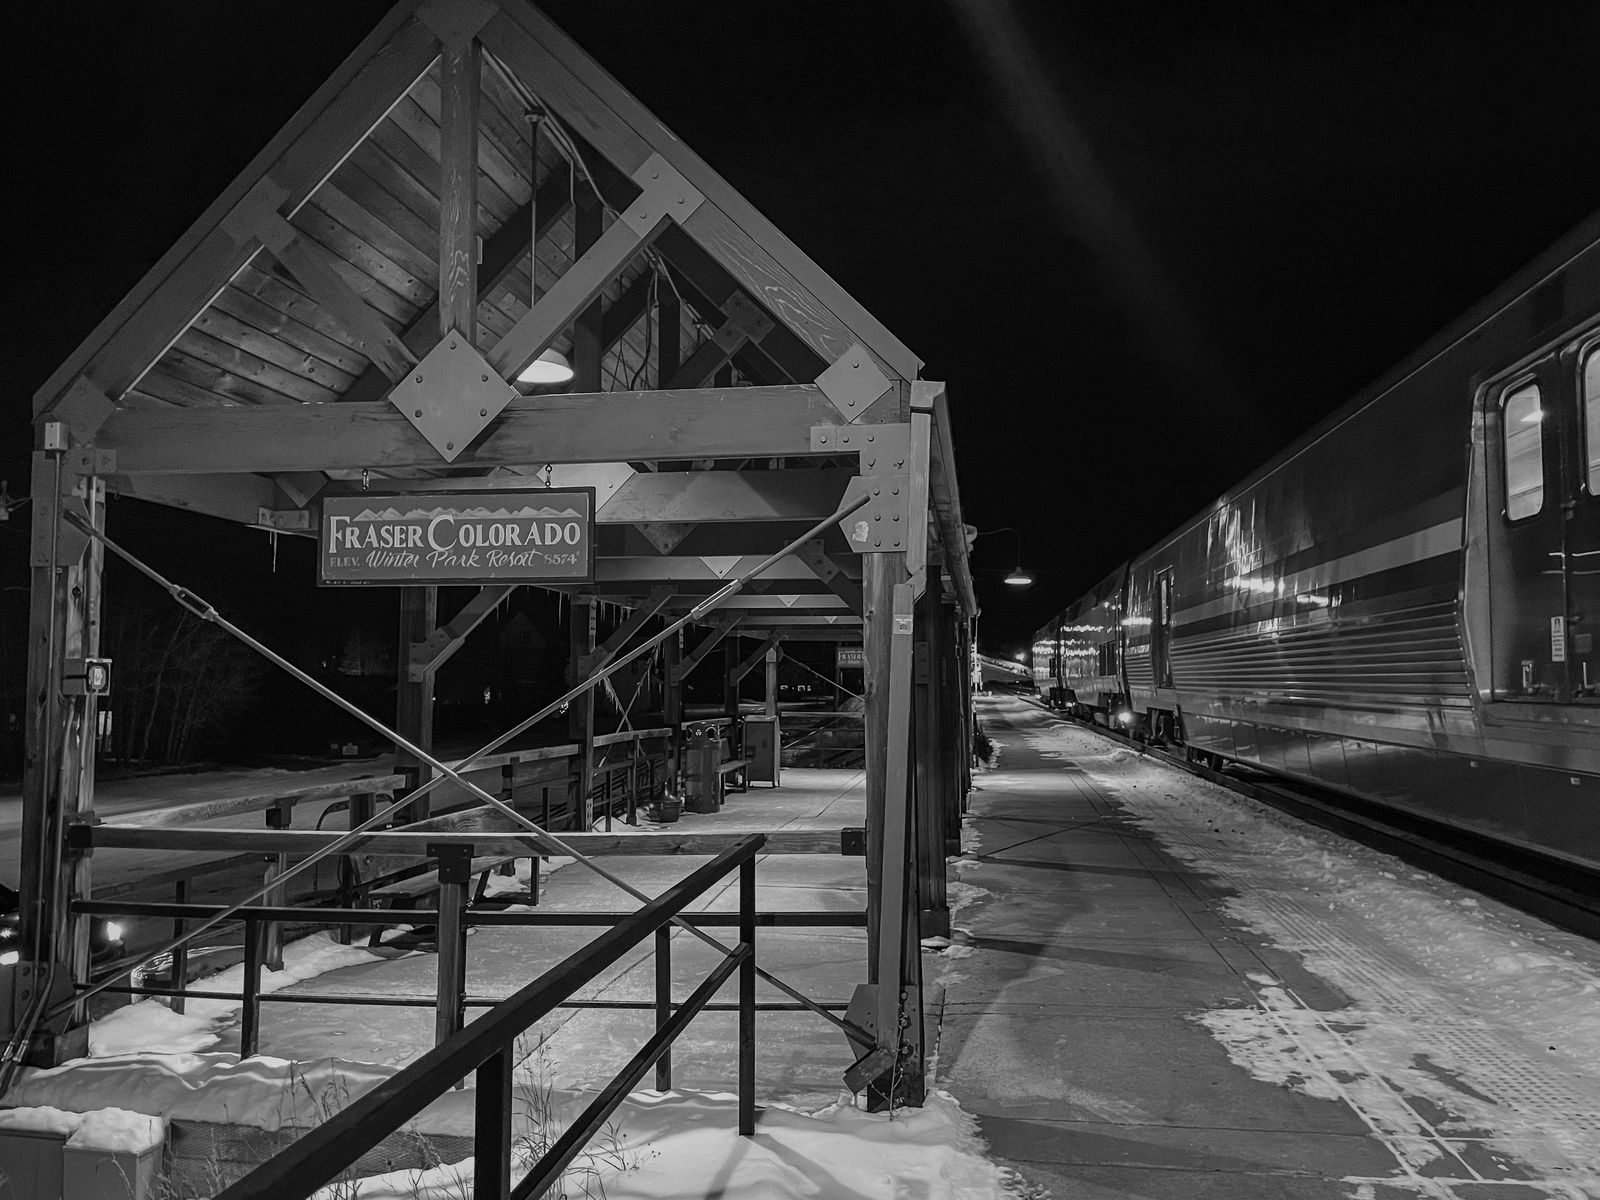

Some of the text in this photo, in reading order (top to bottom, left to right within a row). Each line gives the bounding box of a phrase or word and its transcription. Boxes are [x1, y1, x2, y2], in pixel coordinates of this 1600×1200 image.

[329, 514, 581, 553] FRASER COLORADO
[365, 548, 543, 568] Winter Park Resort
